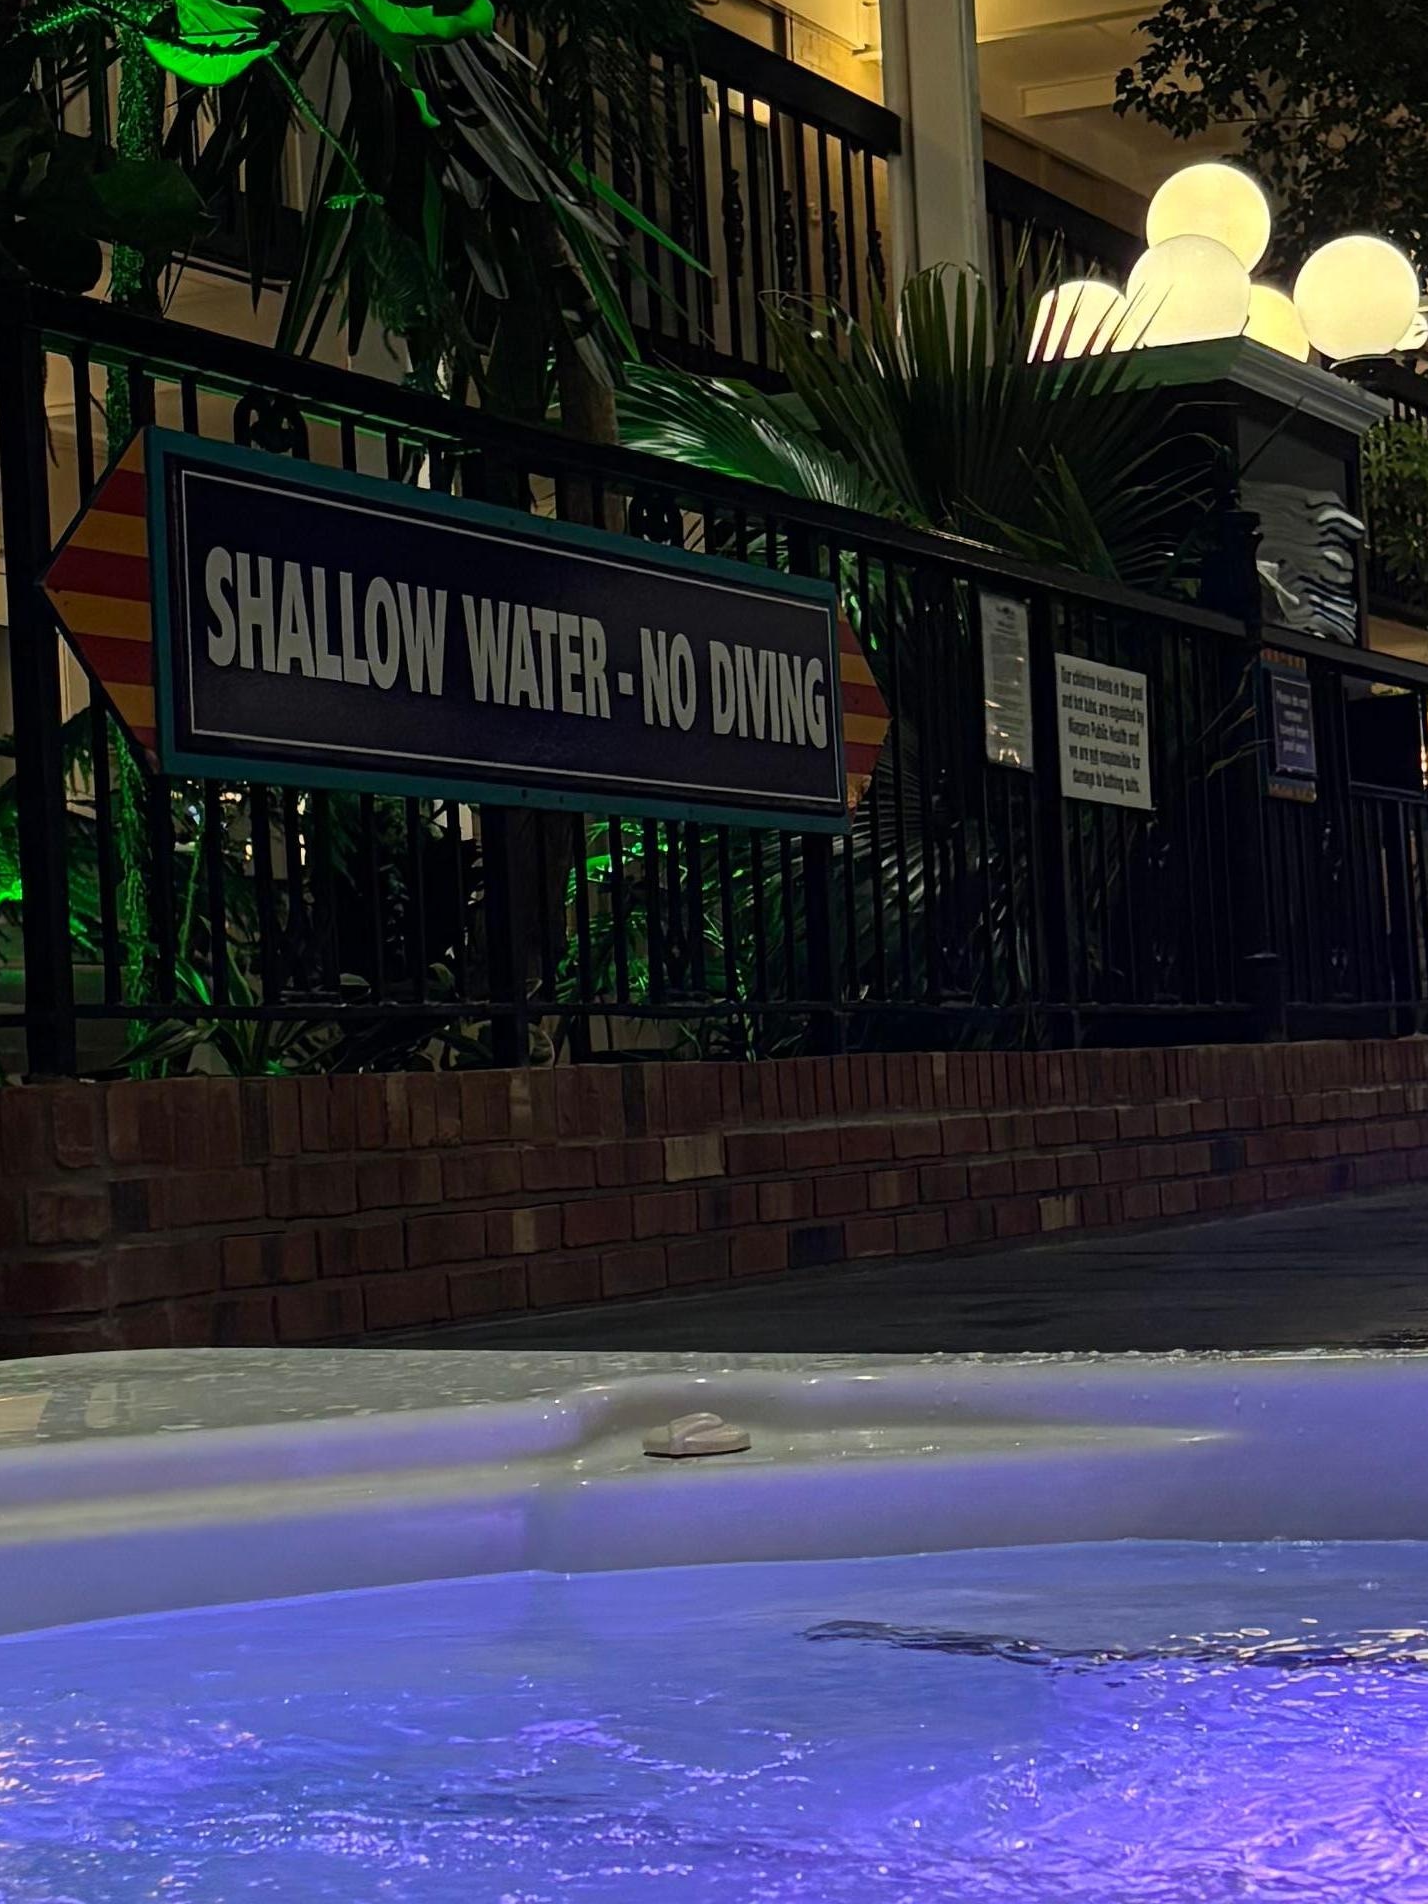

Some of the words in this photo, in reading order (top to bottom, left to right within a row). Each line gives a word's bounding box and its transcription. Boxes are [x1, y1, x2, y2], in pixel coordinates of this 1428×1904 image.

[205, 546, 448, 696] SHALLOW
[462, 594, 612, 720] WATER
[639, 627, 697, 732] NO
[708, 640, 828, 749] DIVING
